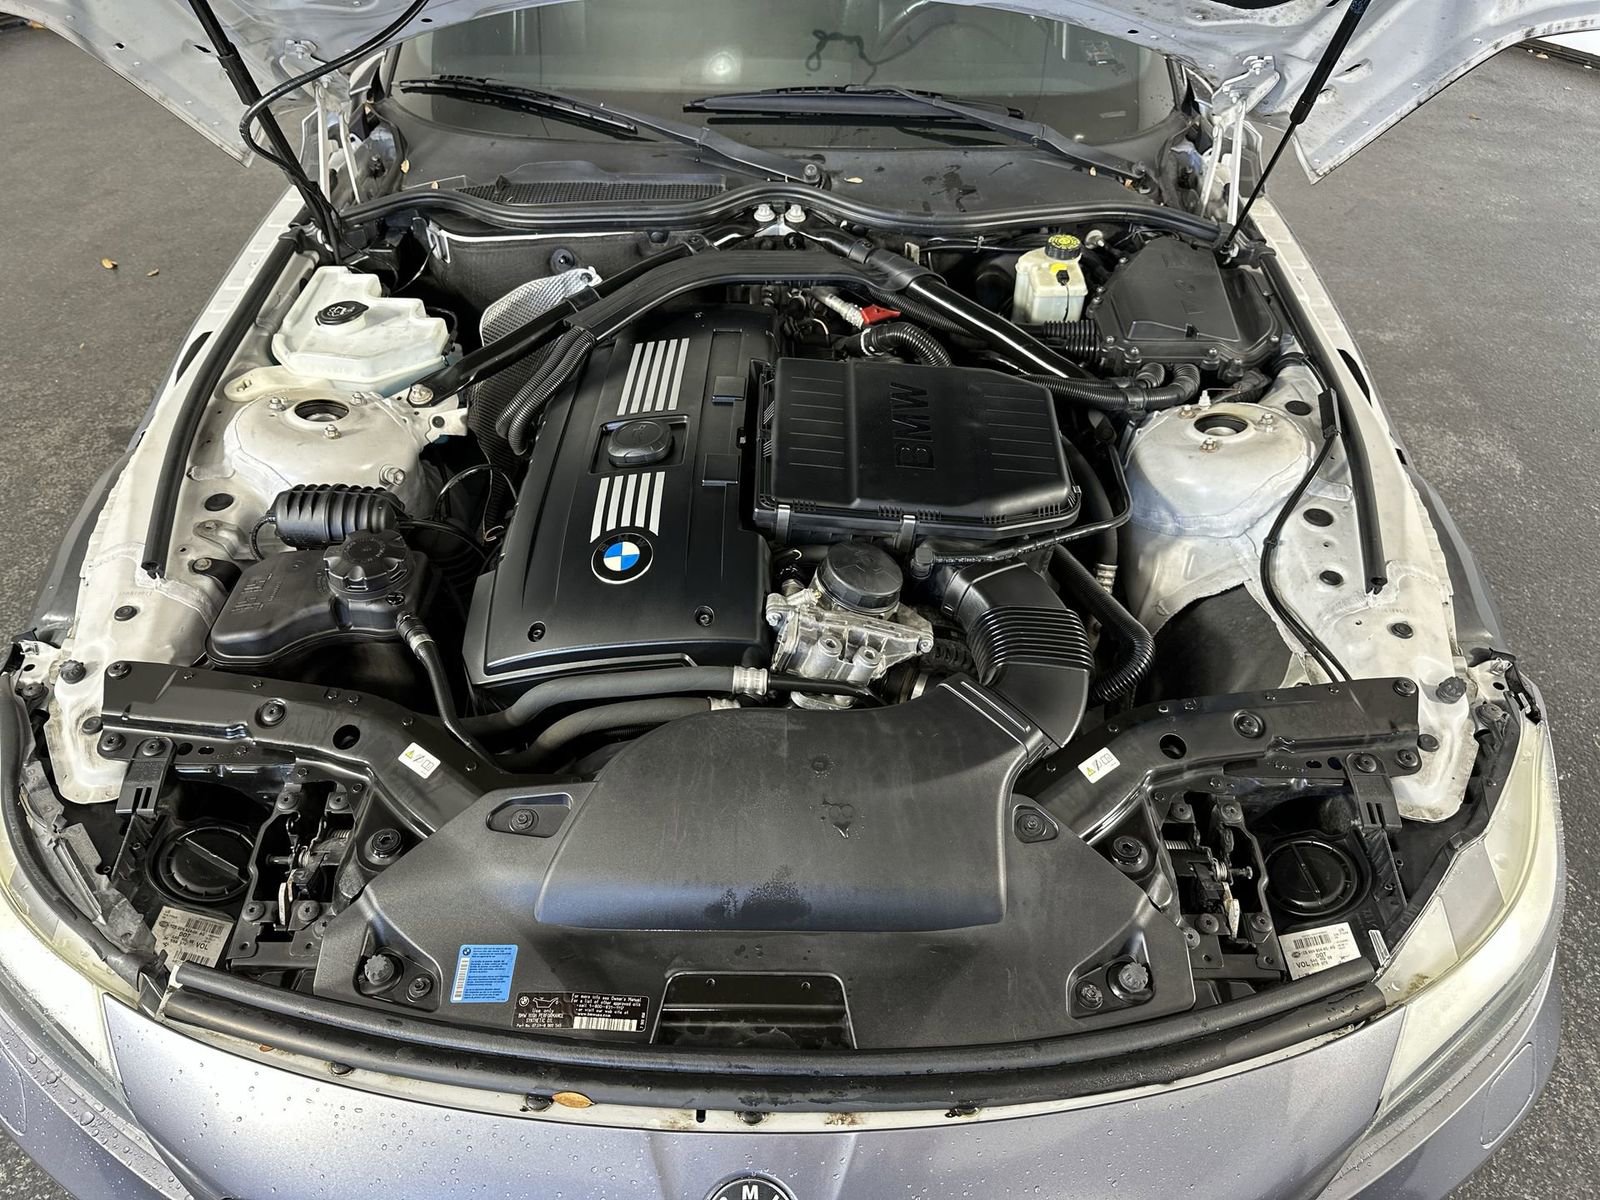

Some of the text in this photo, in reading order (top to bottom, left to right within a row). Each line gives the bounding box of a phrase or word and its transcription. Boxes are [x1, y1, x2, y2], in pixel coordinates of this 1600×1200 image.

[889, 382, 936, 470] BMW
[196, 942, 209, 951] VOL
[1316, 951, 1327, 959] DOT
[1296, 961, 1311, 969] VOL
